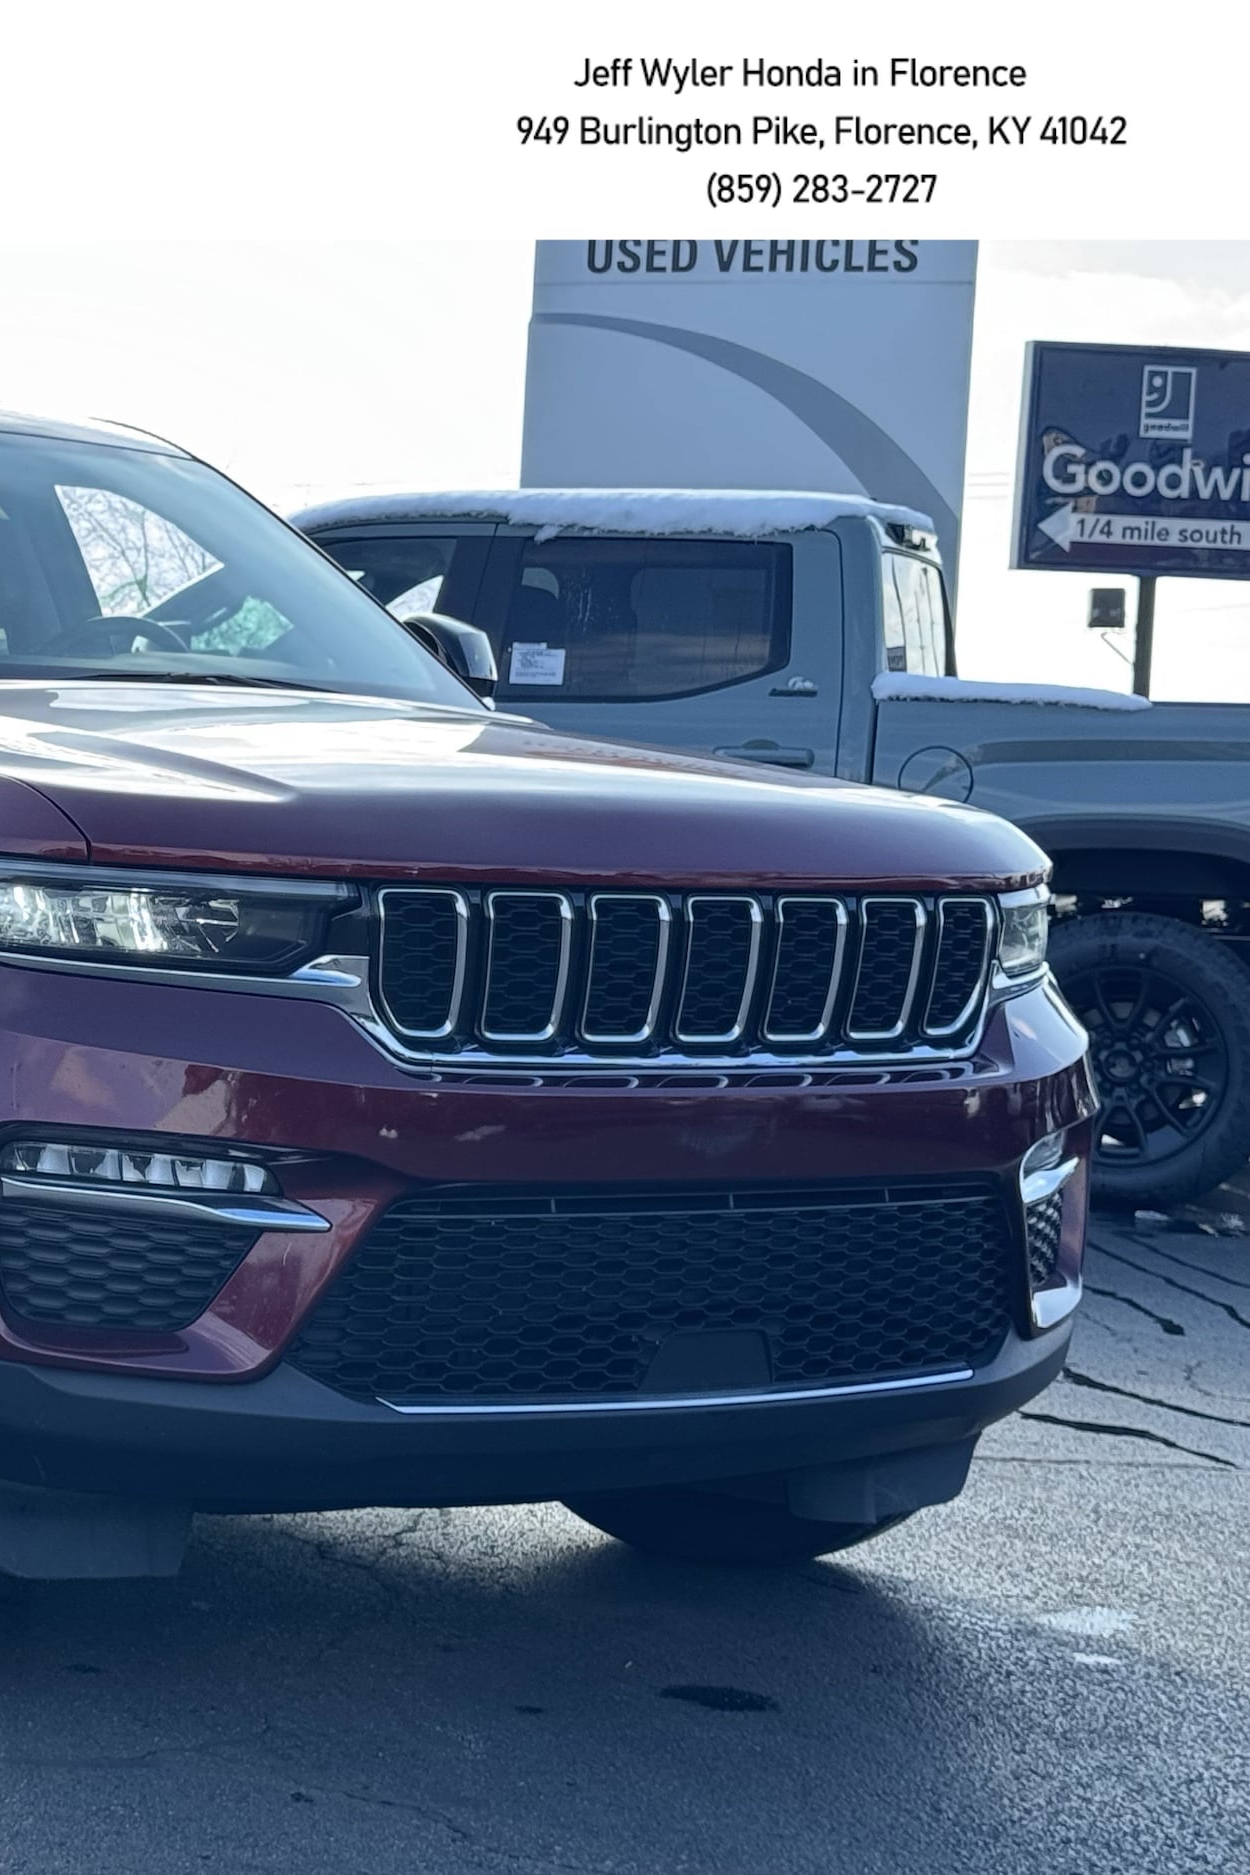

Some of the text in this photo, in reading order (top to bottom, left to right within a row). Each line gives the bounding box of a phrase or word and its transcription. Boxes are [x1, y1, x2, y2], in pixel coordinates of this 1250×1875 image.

[587, 240, 919, 274] USED VEHICLES
[1076, 517, 1243, 546] 1/4 mile south
